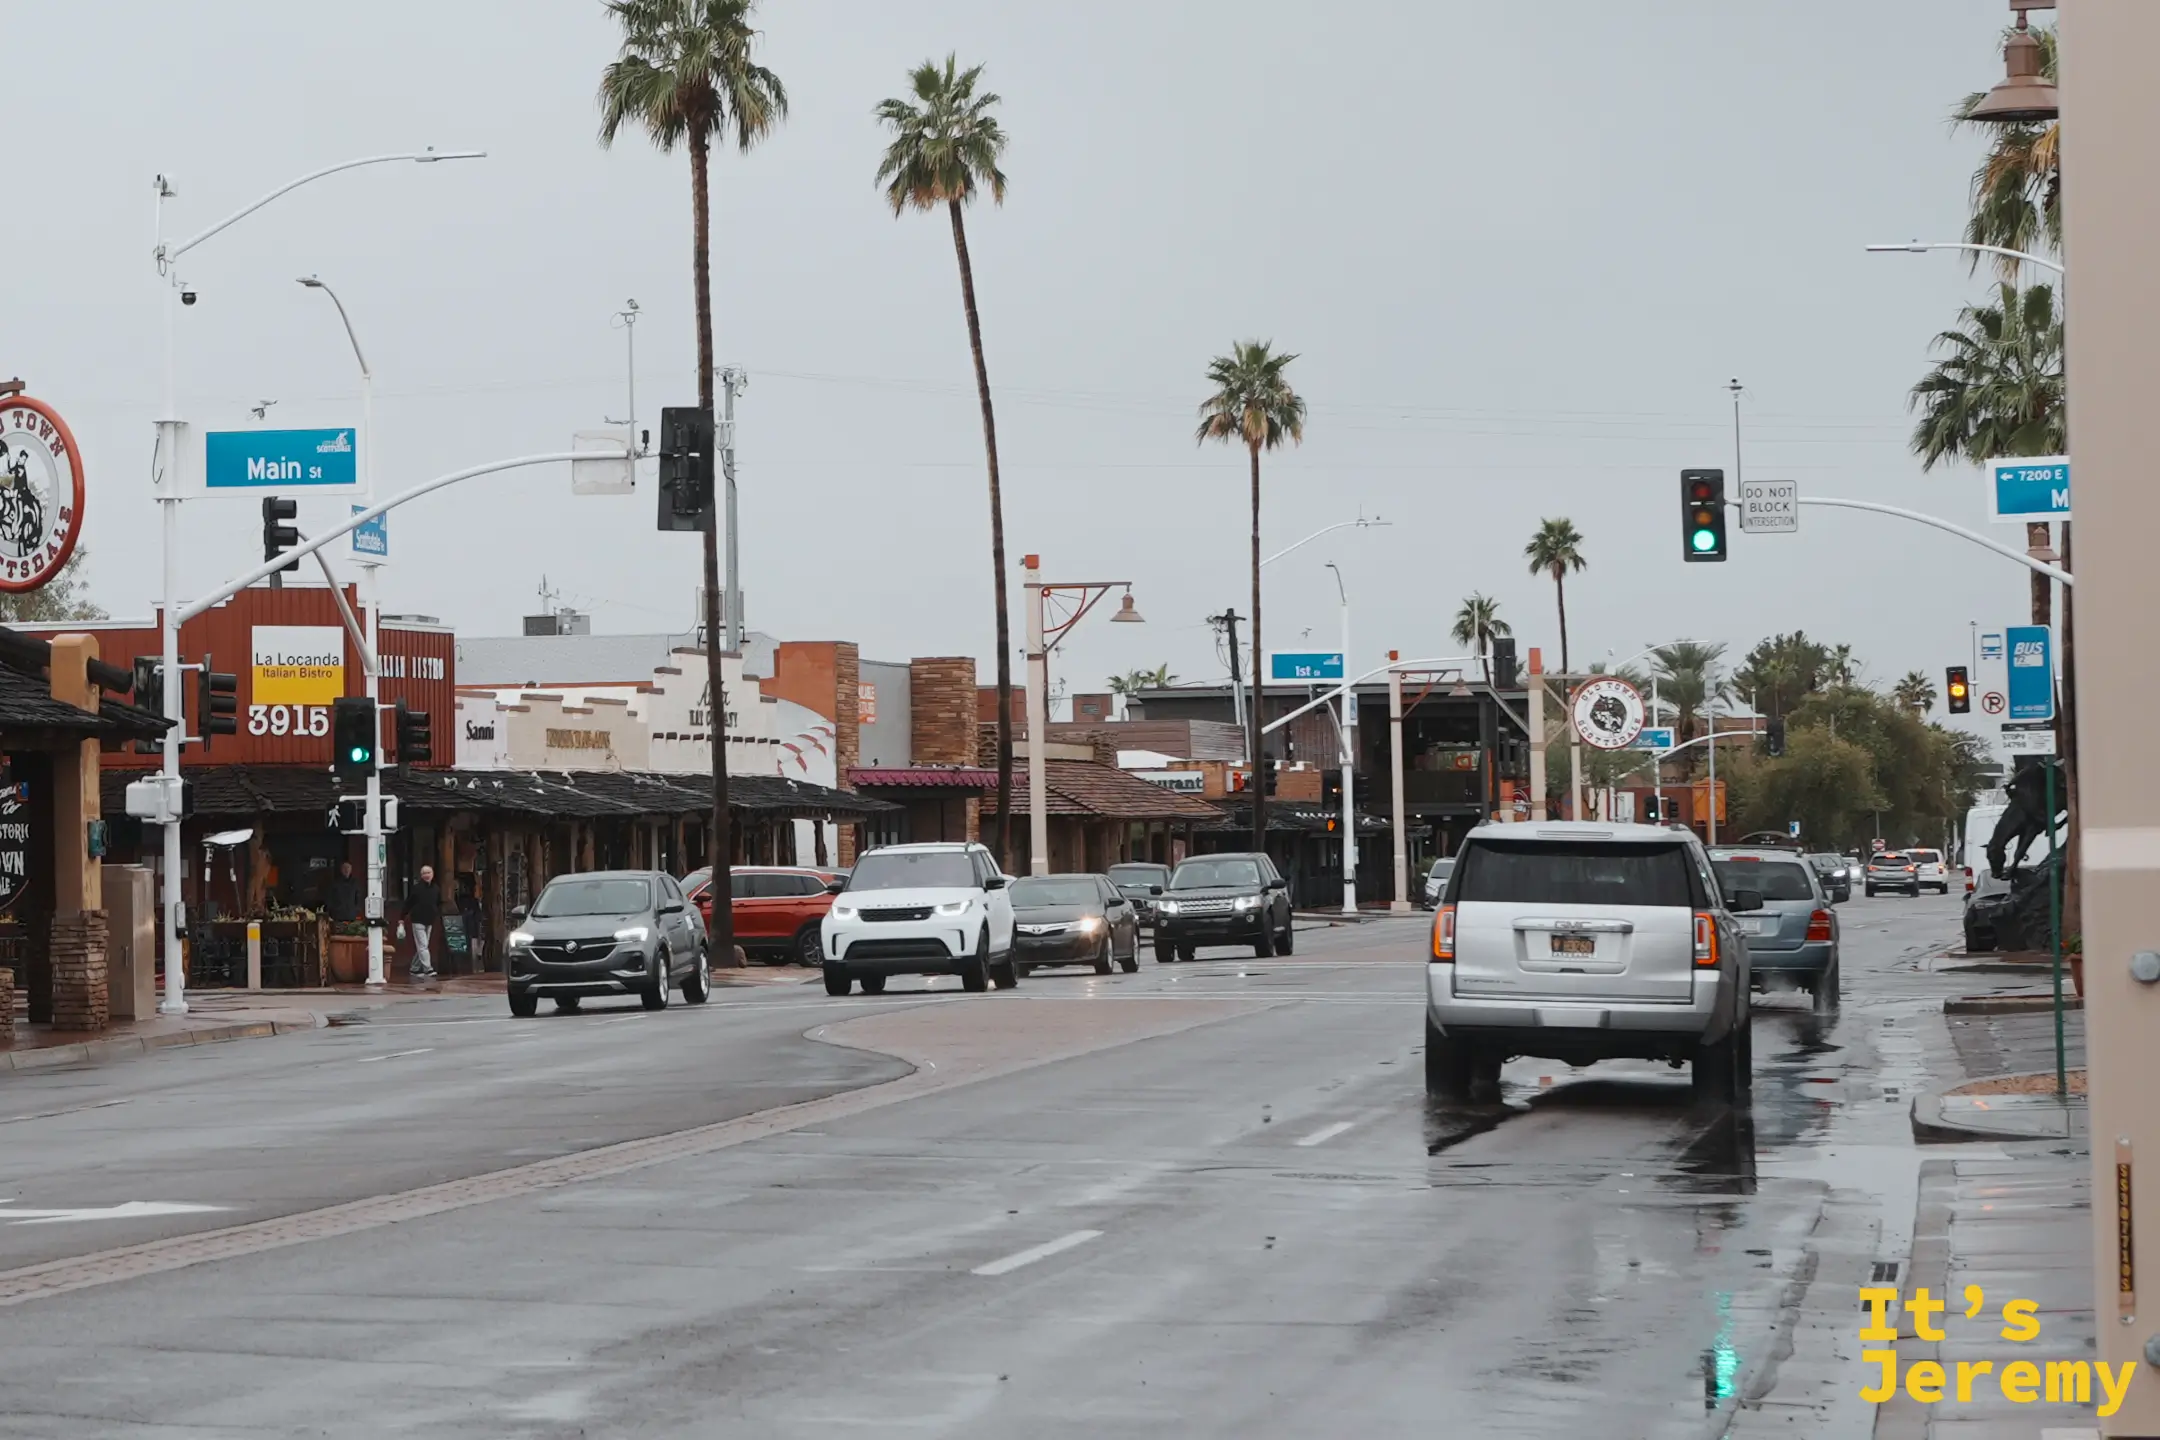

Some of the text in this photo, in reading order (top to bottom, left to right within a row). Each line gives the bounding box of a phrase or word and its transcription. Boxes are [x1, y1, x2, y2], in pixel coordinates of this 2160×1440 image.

[13, 410, 65, 457] TOWN
[247, 456, 322, 480] Main St
[2017, 468, 2063, 481] 7200 E
[1746, 487, 1792, 498] DO NOT
[1749, 502, 1790, 512] BLOCK
[1746, 516, 1795, 526] INTERSECTION
[2013, 641, 2044, 655] BUS
[255, 652, 340, 666] La Locanda
[262, 667, 333, 679] Italian Bistro
[1295, 665, 1310, 676] 1st
[1581, 682, 1636, 701] OLD TOWN
[248, 704, 330, 737] 3915
[466, 719, 495, 741] Sanni
[1578, 717, 1642, 747] SCOTTSDALE
[0, 850, 25, 877] WN
